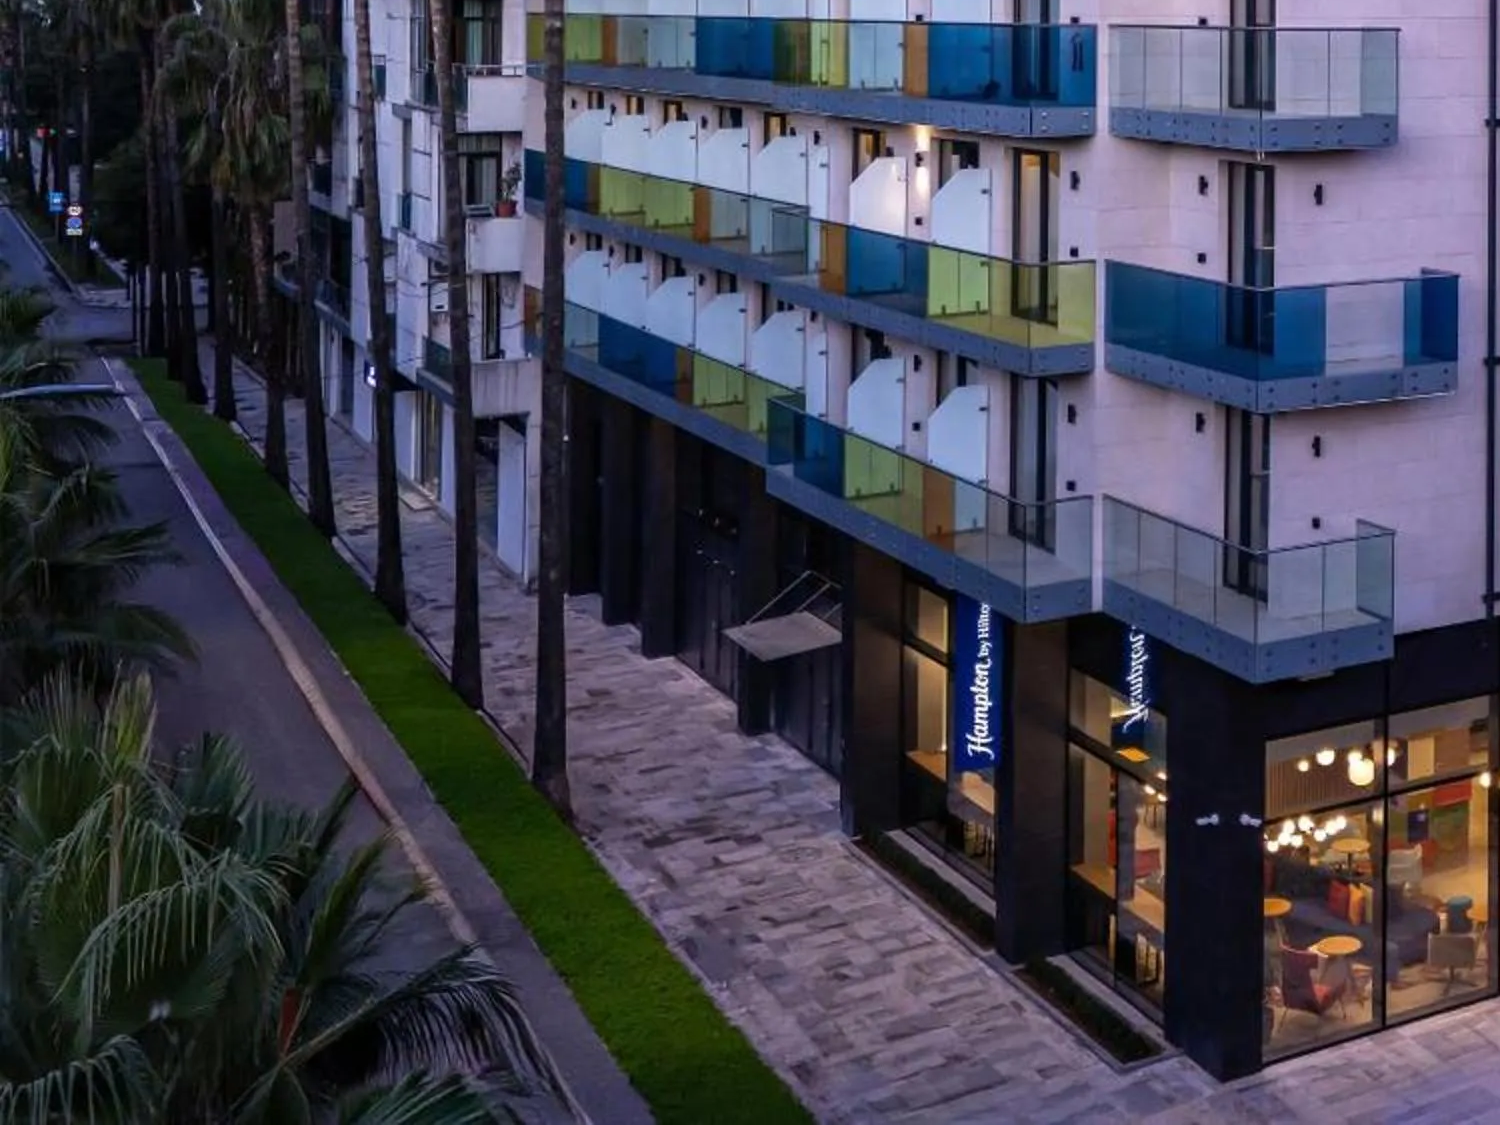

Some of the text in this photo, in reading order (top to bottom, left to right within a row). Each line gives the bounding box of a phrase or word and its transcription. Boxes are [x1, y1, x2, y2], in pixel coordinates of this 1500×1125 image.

[965, 603, 995, 760] Hampton by Hilto
